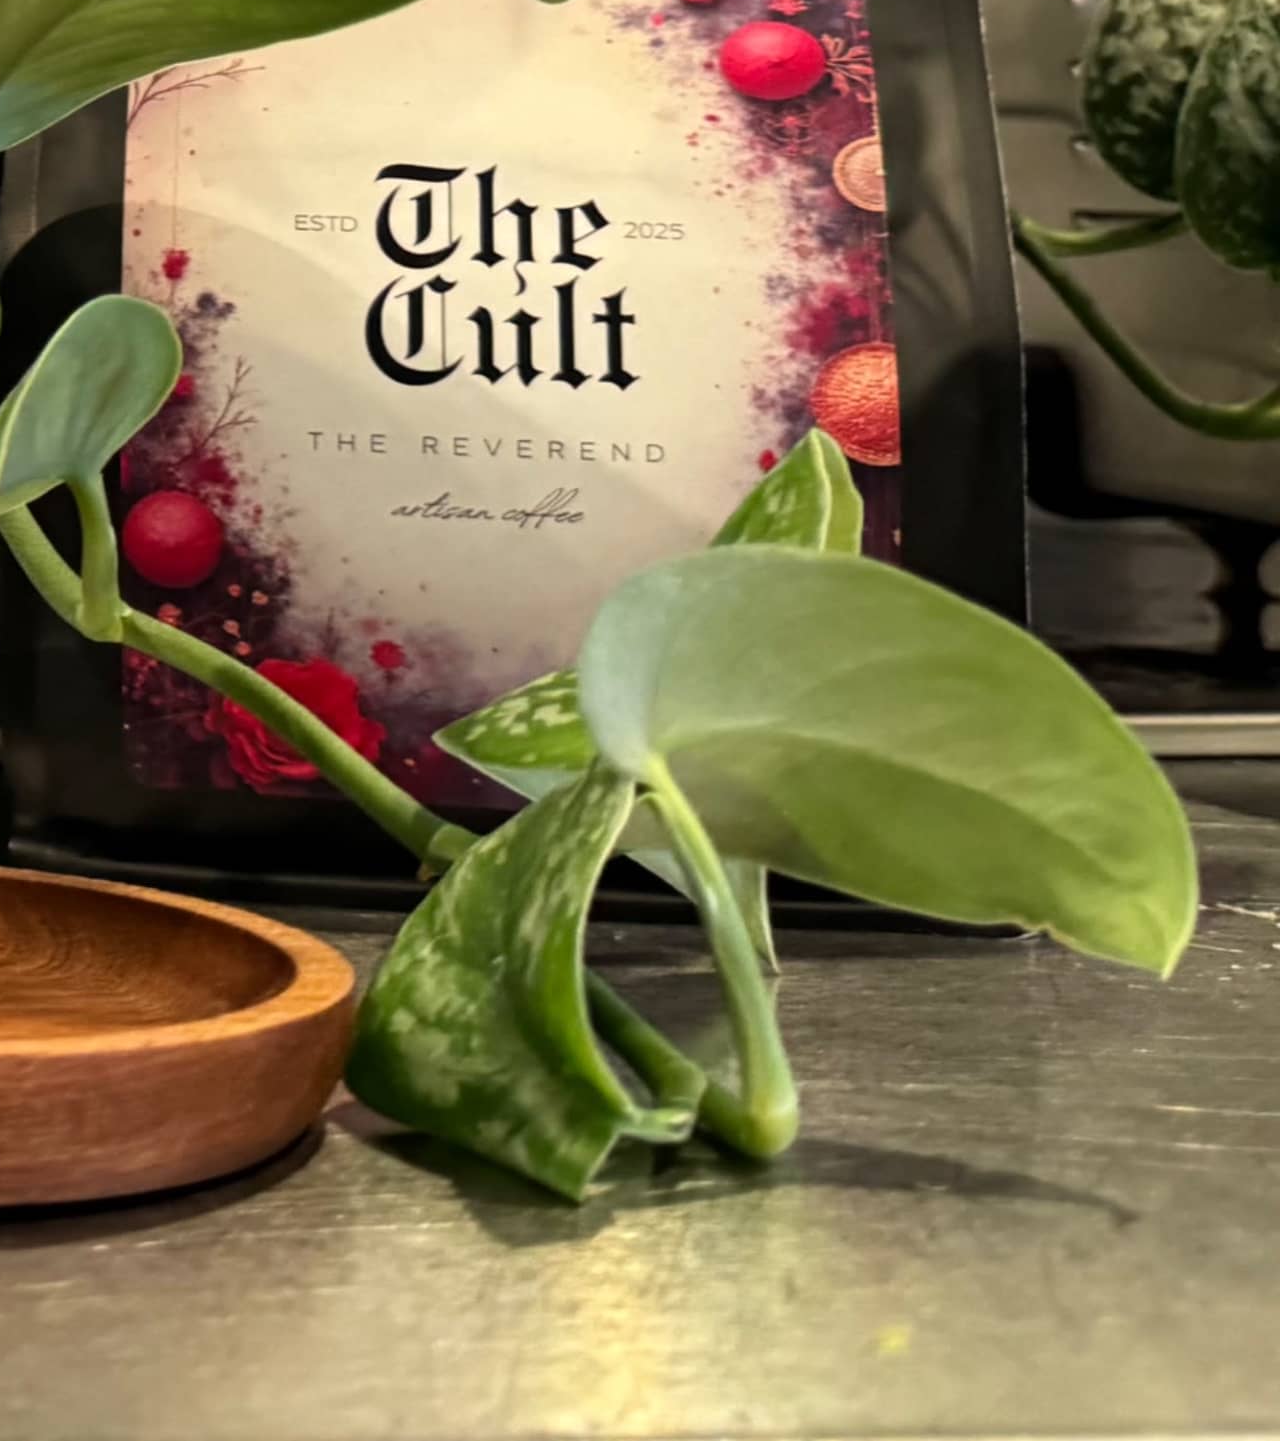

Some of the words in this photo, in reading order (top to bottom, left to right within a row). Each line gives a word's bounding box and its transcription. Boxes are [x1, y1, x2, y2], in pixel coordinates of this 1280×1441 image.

[294, 215, 358, 233] ESTD
[374, 163, 610, 296] The
[623, 221, 685, 241] 2025
[365, 274, 641, 391] Cult
[308, 431, 388, 454] THE
[422, 436, 666, 463] REVEREND
[390, 491, 496, 521] artisan
[500, 487, 585, 530] coffee
